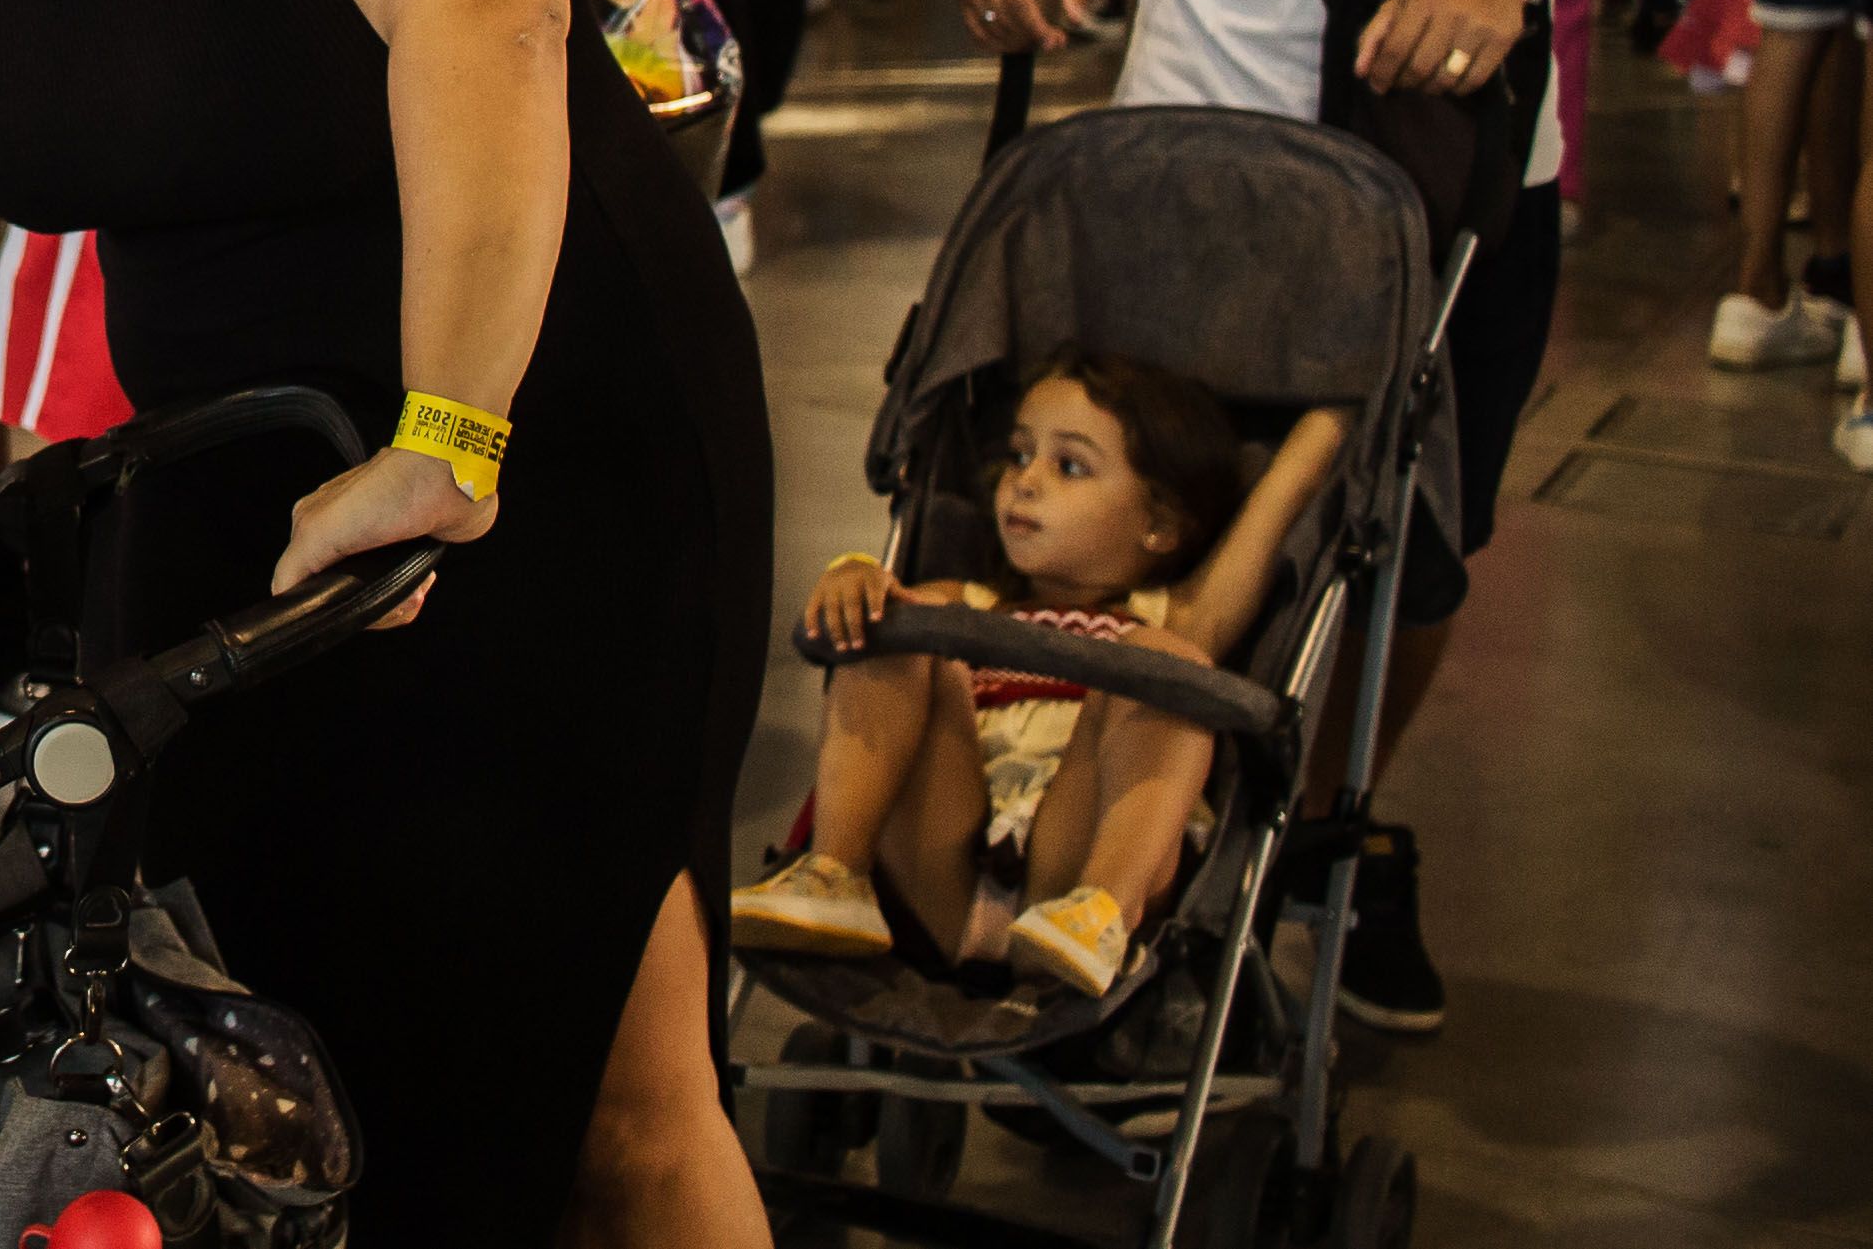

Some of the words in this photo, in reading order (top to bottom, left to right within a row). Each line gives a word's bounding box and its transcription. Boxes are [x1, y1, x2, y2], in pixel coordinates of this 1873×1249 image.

[417, 405, 451, 426] 2022
[412, 426, 421, 438] 18
[459, 417, 490, 436] JEREZ
[434, 432, 444, 444] 17
